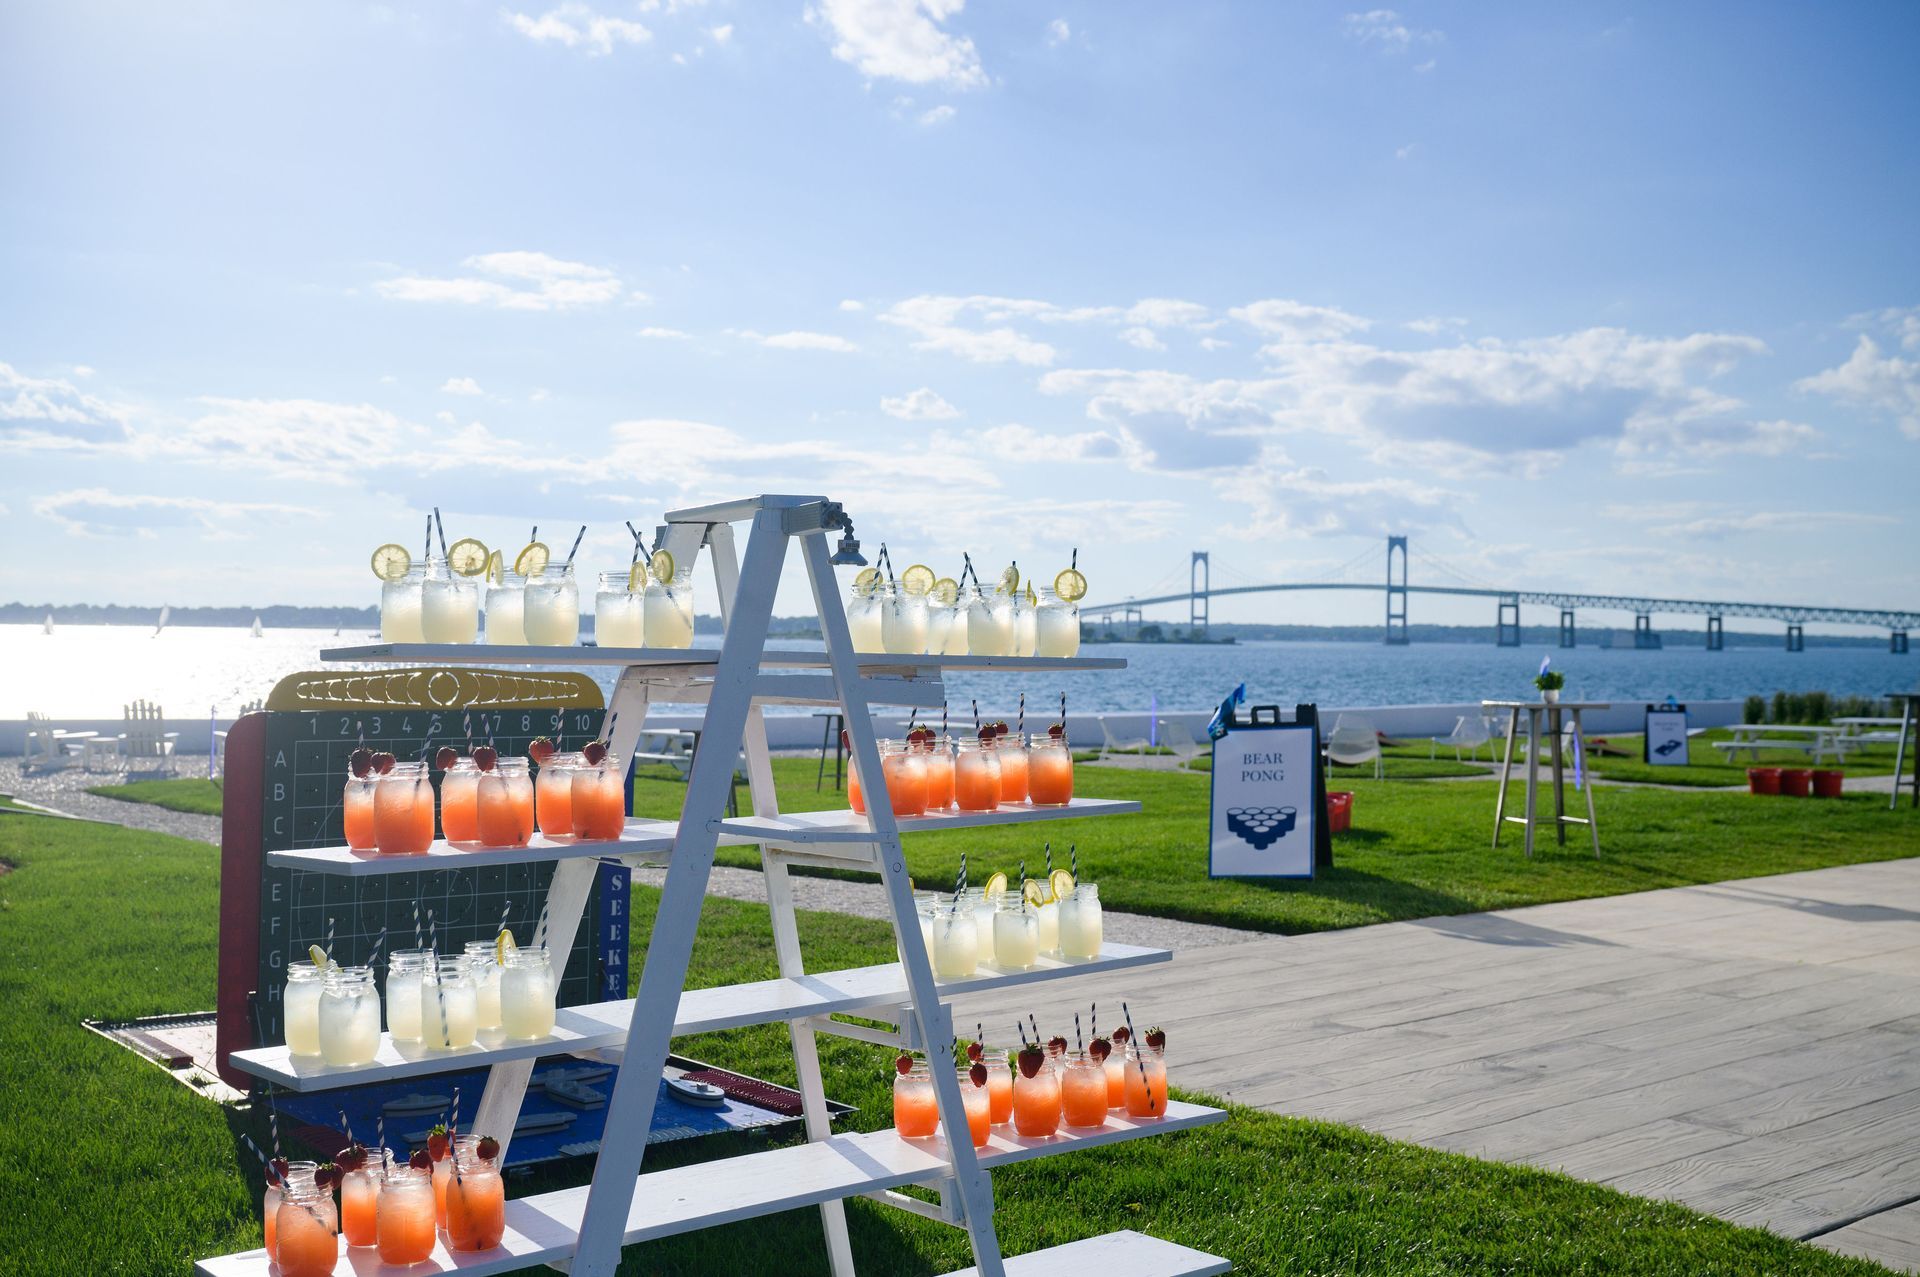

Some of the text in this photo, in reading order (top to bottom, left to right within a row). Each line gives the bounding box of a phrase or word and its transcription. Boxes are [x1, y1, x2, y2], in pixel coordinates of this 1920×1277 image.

[310, 717, 316, 735] 1
[340, 717, 350, 735] 2
[372, 716, 381, 734] 3
[402, 716, 412, 734] 4
[493, 715, 501, 732] 7
[521, 715, 530, 732] 8
[550, 715, 559, 731] 9
[575, 714, 590, 731] 10
[274, 749, 287, 767] A
[1243, 753, 1284, 765] BEAR
[1241, 770, 1284, 782] PONG
[274, 783, 285, 801] B
[274, 816, 283, 834] C
[272, 883, 282, 901] E
[271, 917, 281, 935] F
[607, 874, 623, 1001] SEEKE
[269, 950, 281, 968] G
[268, 984, 280, 1002] H
